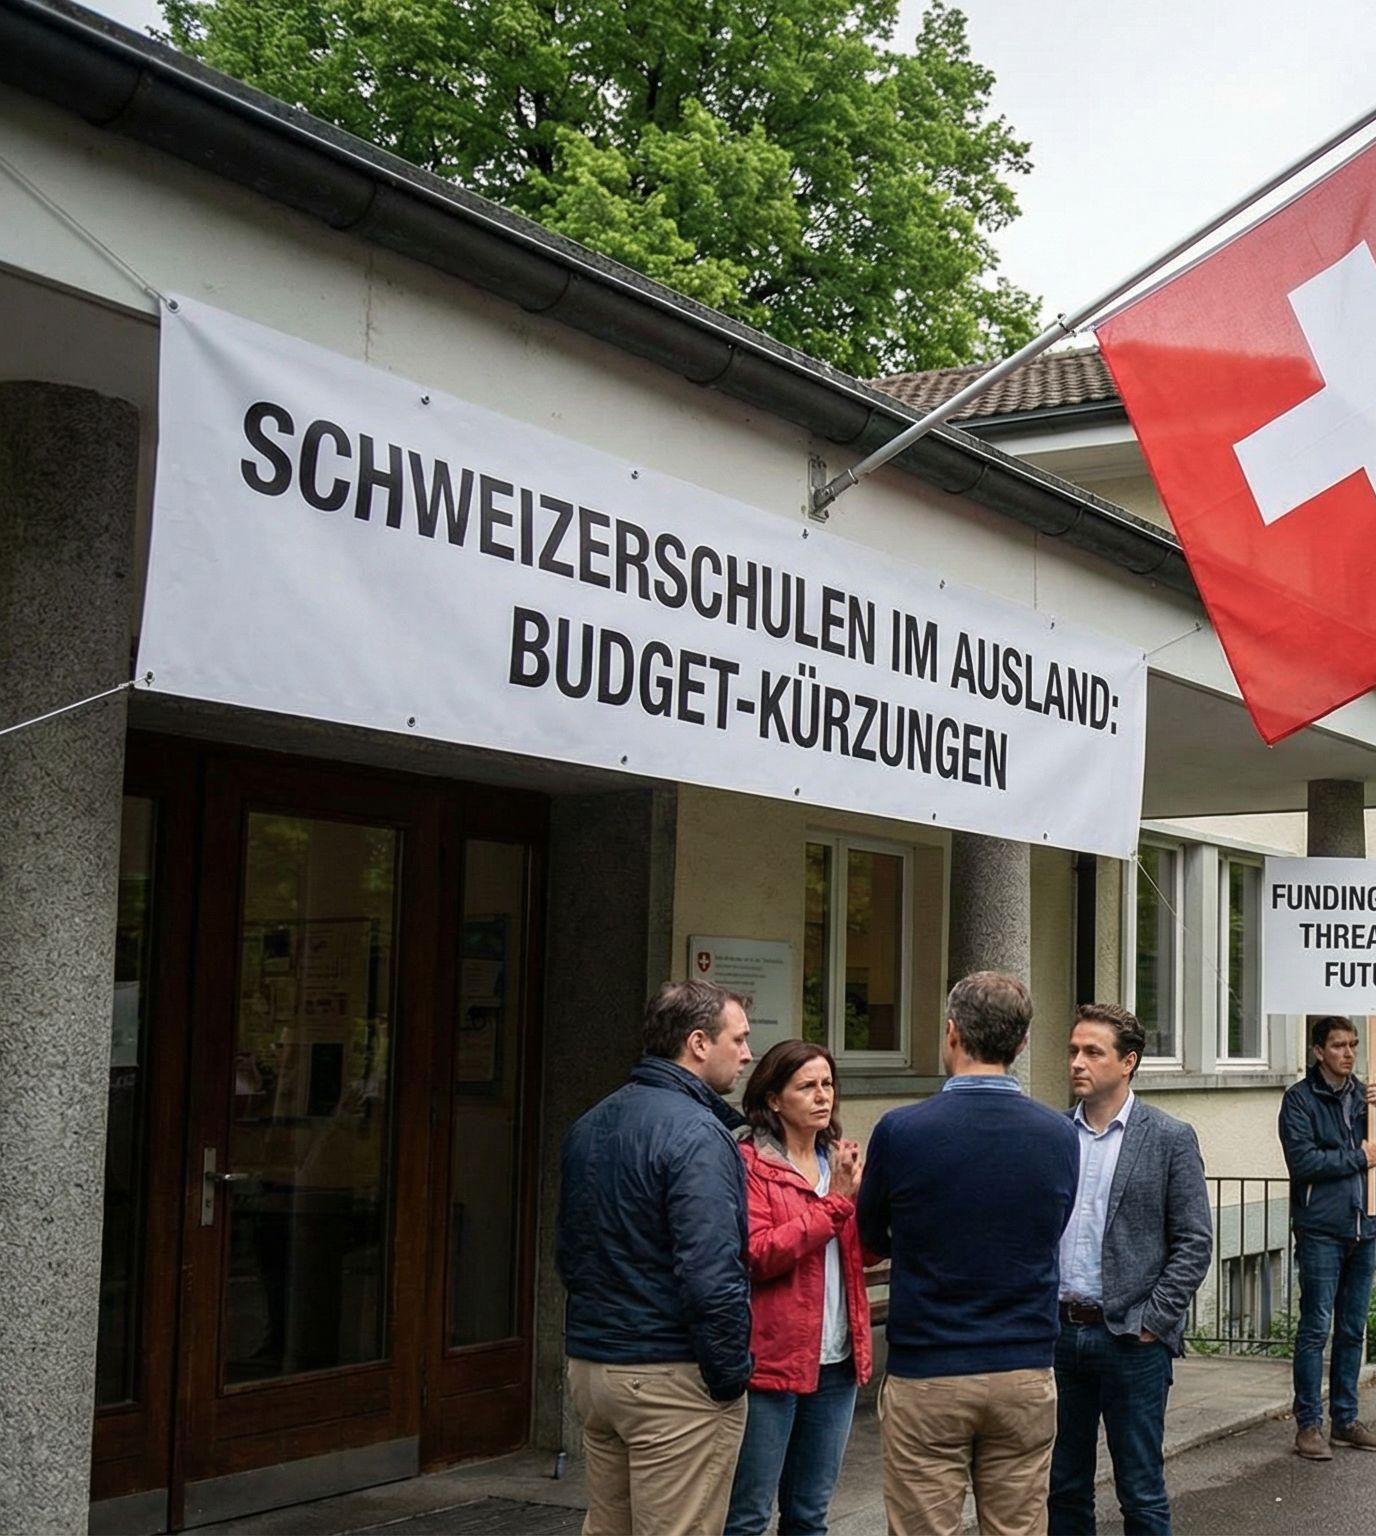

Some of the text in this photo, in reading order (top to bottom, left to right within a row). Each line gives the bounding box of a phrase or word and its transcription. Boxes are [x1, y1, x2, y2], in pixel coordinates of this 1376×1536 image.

[240, 401, 1119, 735] SCHWEIZERSCHULEN IM AUSLAND:
[508, 605, 1009, 792] BUDGET-KÜRZUNGEN
